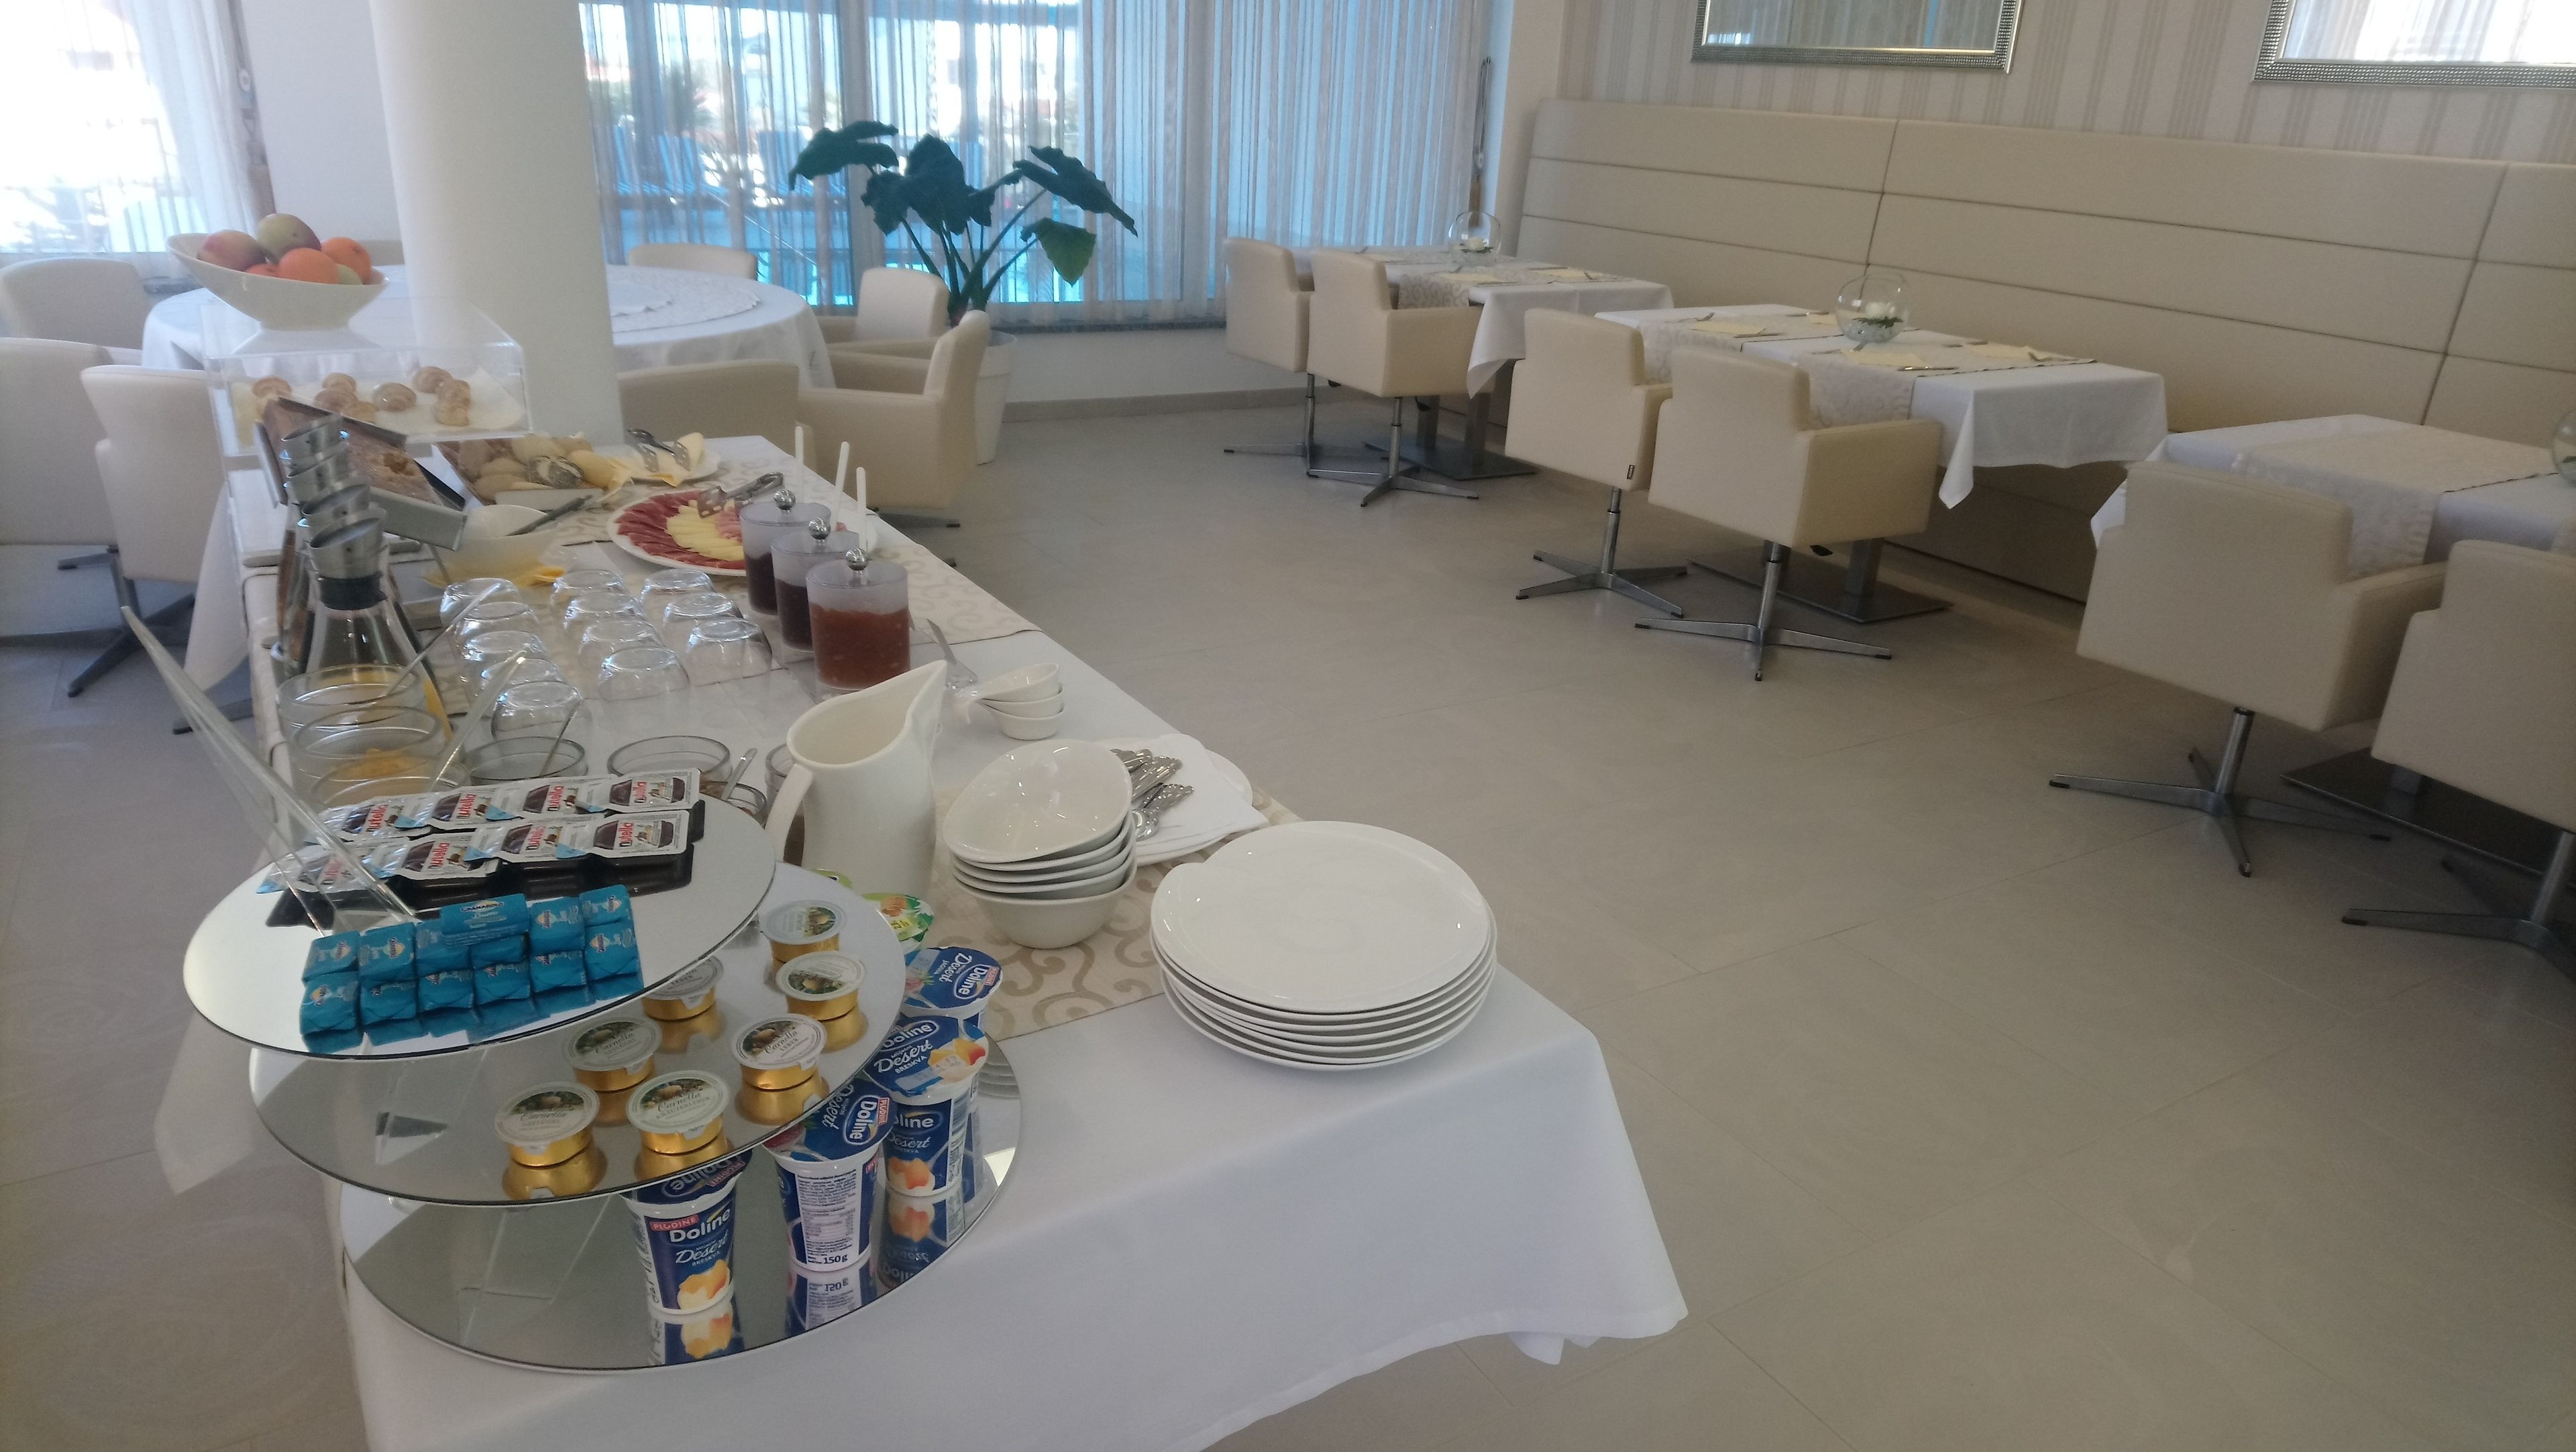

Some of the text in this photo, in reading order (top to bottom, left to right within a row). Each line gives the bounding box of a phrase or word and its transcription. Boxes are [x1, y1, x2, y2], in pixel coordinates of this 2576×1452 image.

[547, 785, 565, 812] nutella
[633, 781, 647, 803] nutella
[366, 804, 388, 832] nutella
[456, 793, 477, 819] nutella
[526, 826, 547, 850] nutella
[619, 822, 634, 847] nutella
[428, 842, 450, 869] nutella
[461, 901, 505, 912] GRANAROLO
[939, 952, 973, 983] Desert
[958, 967, 989, 995] Doline
[883, 1025, 933, 1048] Doline
[873, 1040, 933, 1073] Desert
[894, 1055, 928, 1074] BRESKVA
[849, 1101, 877, 1139] Doline
[894, 1113, 934, 1129] line
[669, 1208, 731, 1243] Doline
[676, 1229, 729, 1264] Desert
[823, 1255, 841, 1265] 150
[842, 1254, 849, 1262] g
